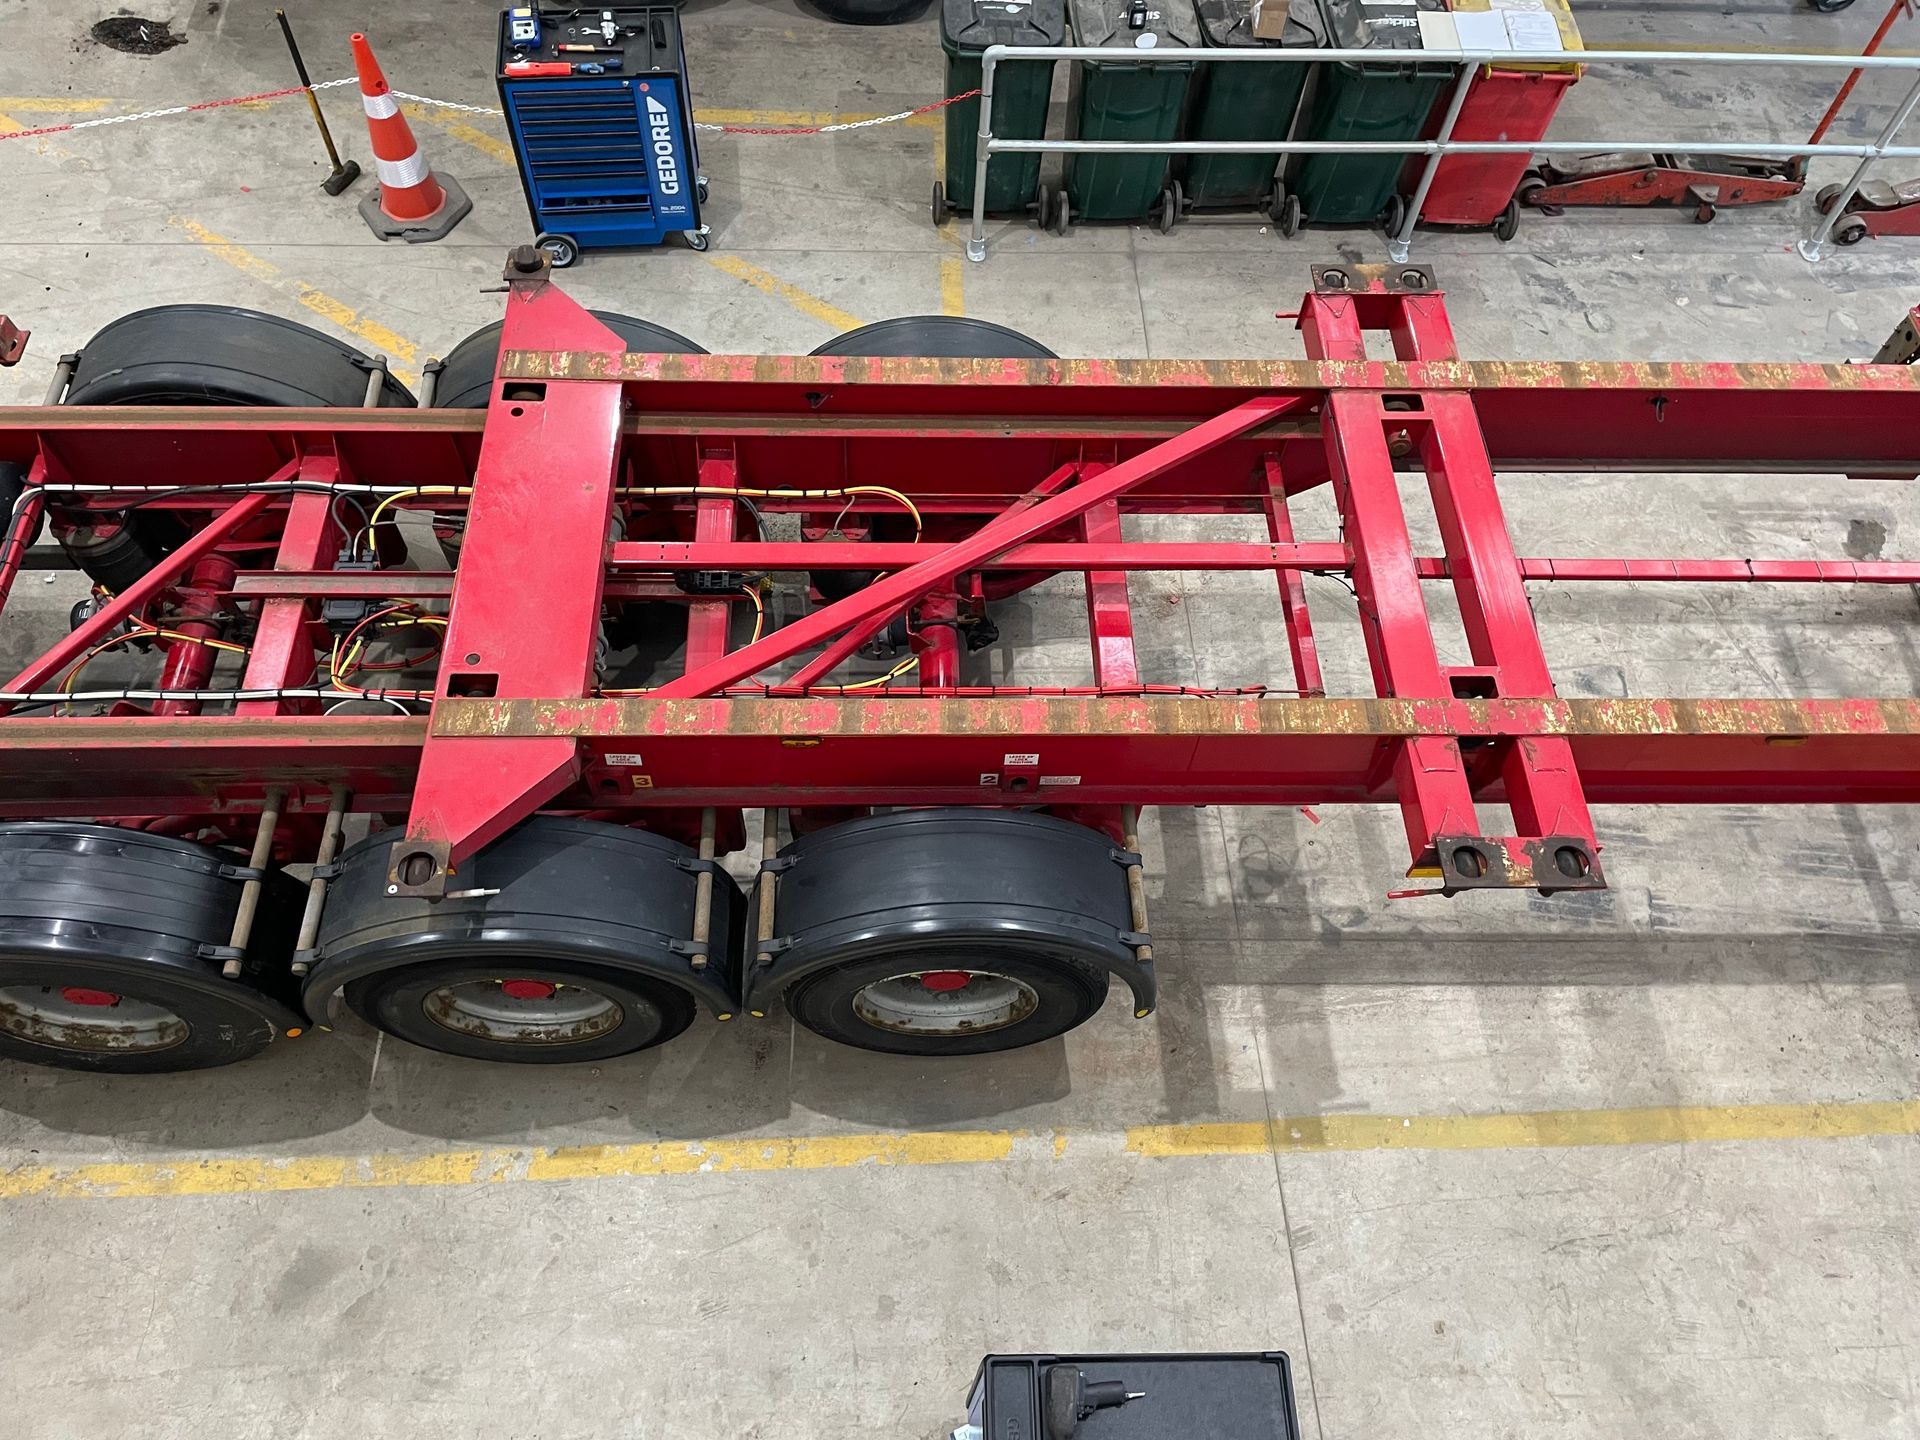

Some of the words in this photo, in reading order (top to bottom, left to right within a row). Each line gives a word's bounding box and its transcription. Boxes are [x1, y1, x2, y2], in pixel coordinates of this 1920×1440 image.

[1118, 11, 1161, 20] Slir
[1376, 18, 1417, 27] Slicker
[649, 113, 679, 194] GEDORE
[635, 777, 650, 786] 3
[982, 775, 996, 784] 2
